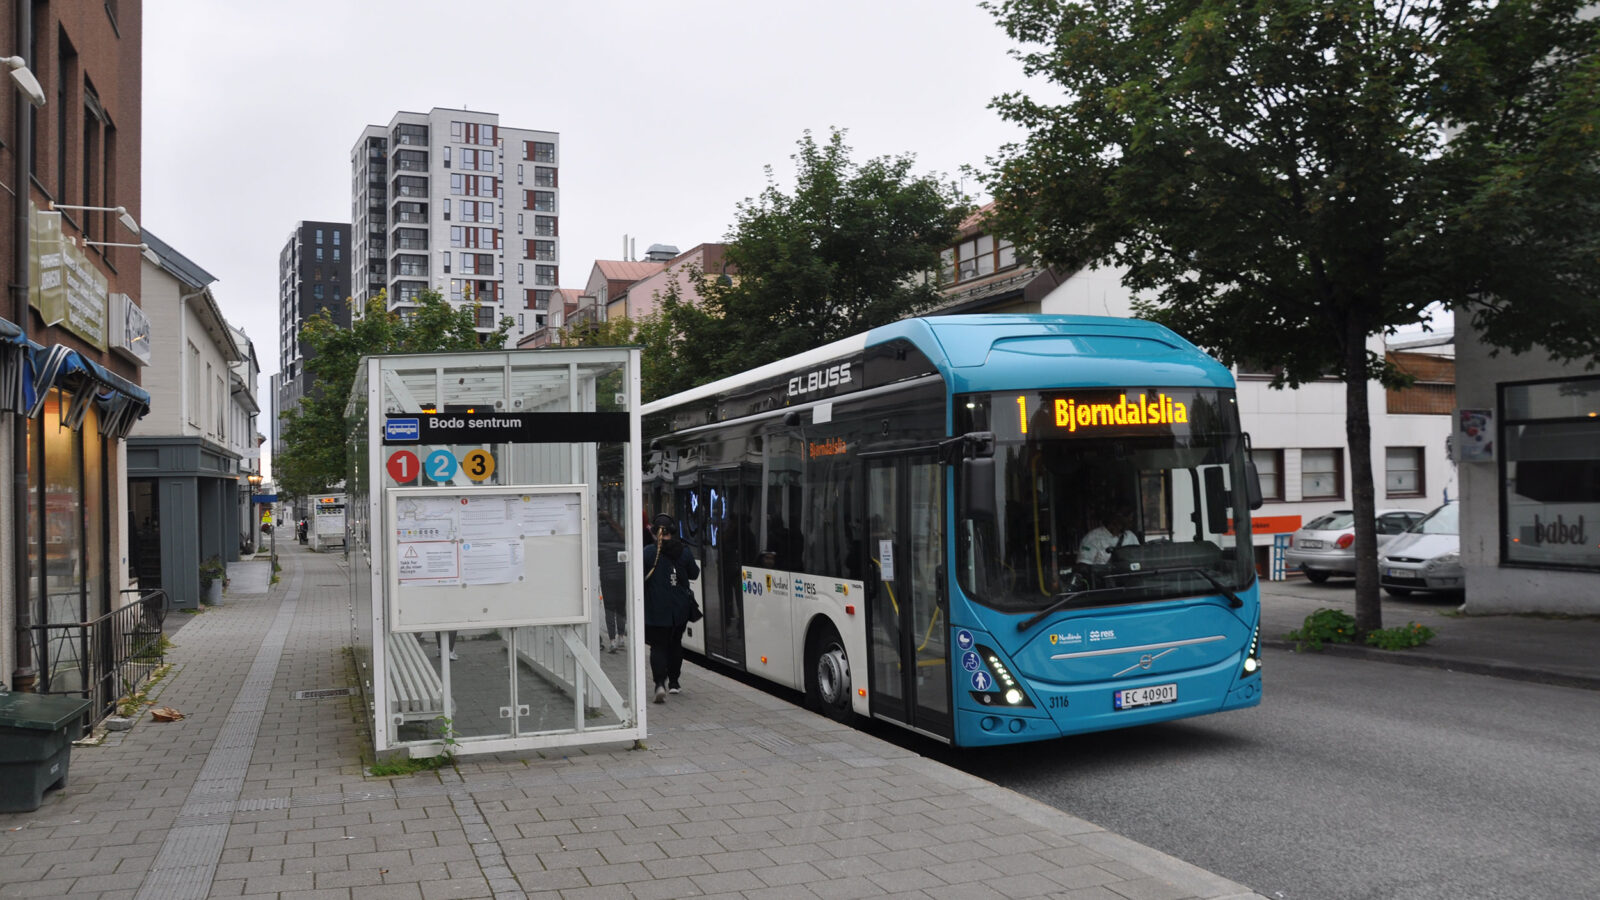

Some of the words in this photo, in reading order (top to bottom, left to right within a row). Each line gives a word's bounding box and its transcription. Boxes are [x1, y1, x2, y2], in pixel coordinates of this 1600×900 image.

[788, 362, 852, 396] ELBUSS
[429, 417, 465, 429] Bodø
[468, 417, 522, 429] sentrum
[1016, 396, 1028, 434] 1
[1054, 393, 1189, 433] Bjørndalslia
[396, 455, 408, 477] 1
[433, 455, 450, 477] 2
[471, 454, 486, 476] 3
[1534, 513, 1588, 545] babel
[804, 581, 817, 595] reis
[1100, 629, 1115, 638] reis
[1049, 696, 1069, 709] 3116
[1125, 691, 1138, 704] EC
[1142, 687, 1174, 701] 40901
